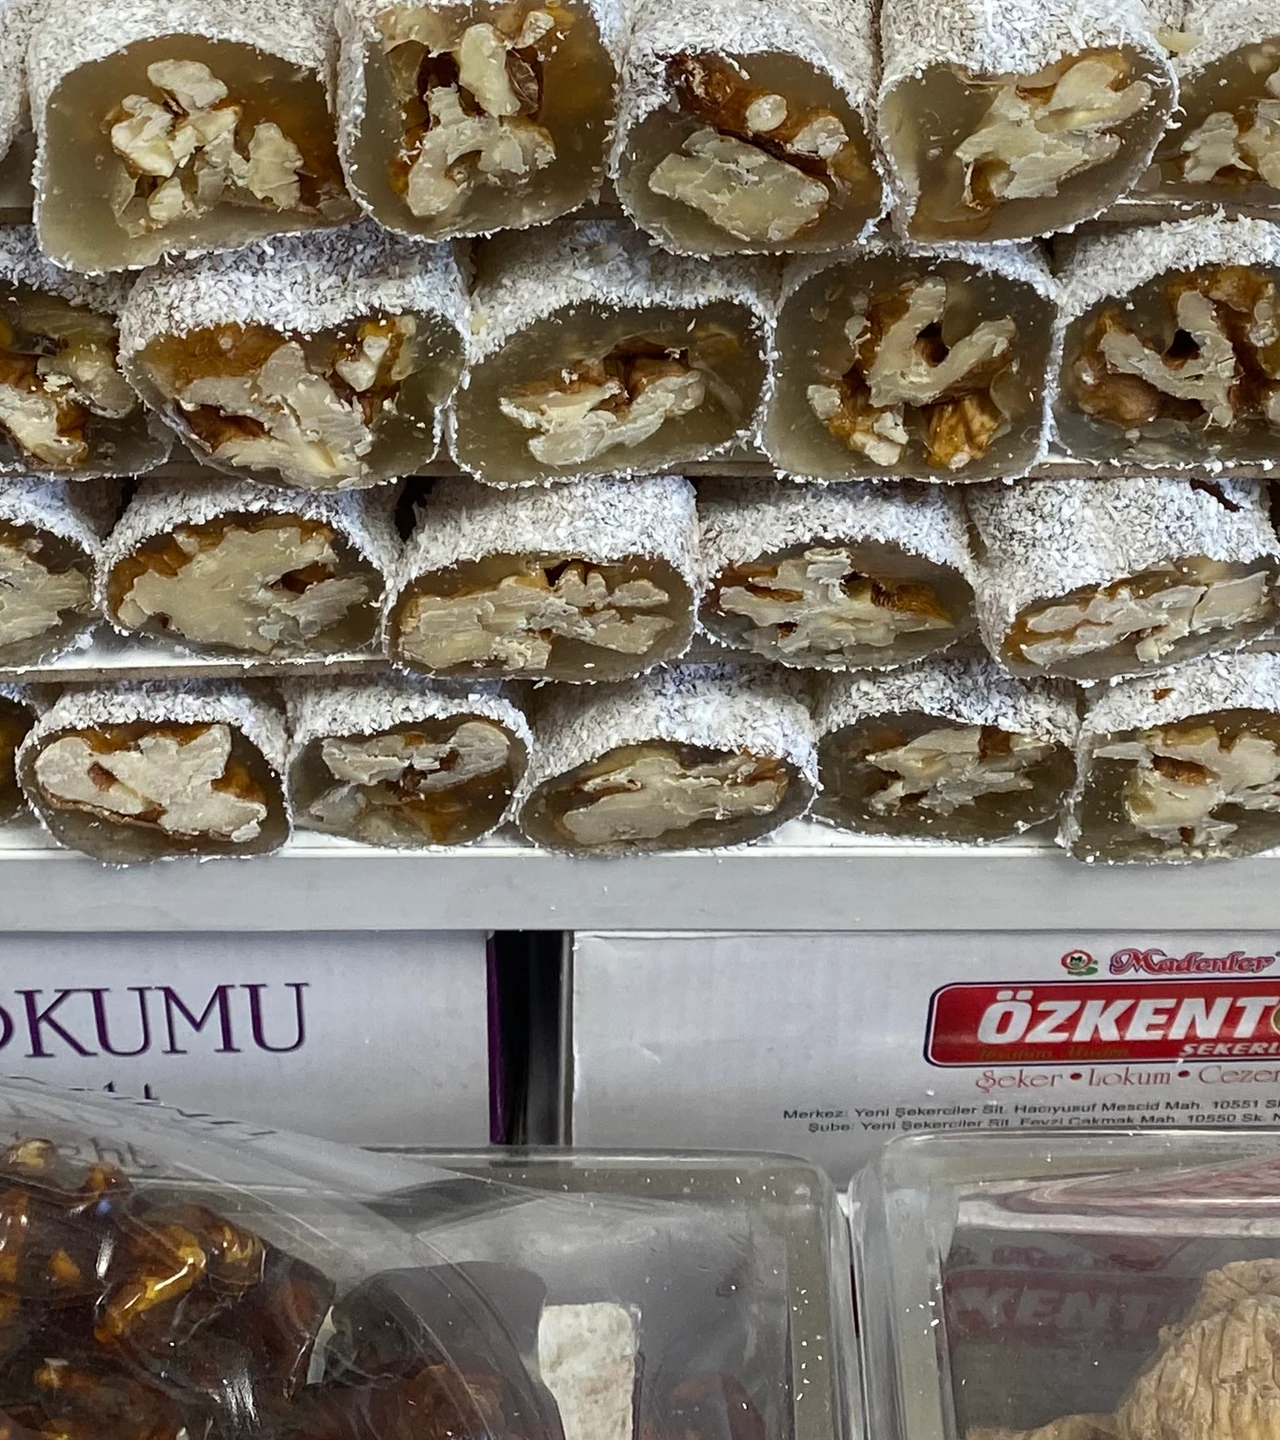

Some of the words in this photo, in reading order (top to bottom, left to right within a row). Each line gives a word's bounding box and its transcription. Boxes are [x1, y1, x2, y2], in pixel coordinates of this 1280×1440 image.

[1109, 948, 1276, 976] Madenler
[976, 990, 1280, 1045] ÖZKENT
[975, 1067, 1064, 1093] Şeker
[1088, 1065, 1171, 1087] Lokum
[783, 1109, 848, 1120] Merkez:
[854, 1107, 890, 1118] Yeni
[895, 1106, 977, 1119] Şekerciler
[1102, 1102, 1160, 1112] Mescid
[1213, 1100, 1258, 1110] 10551
[861, 1120, 896, 1131] Yeni
[1187, 1113, 1237, 1124] 10550
